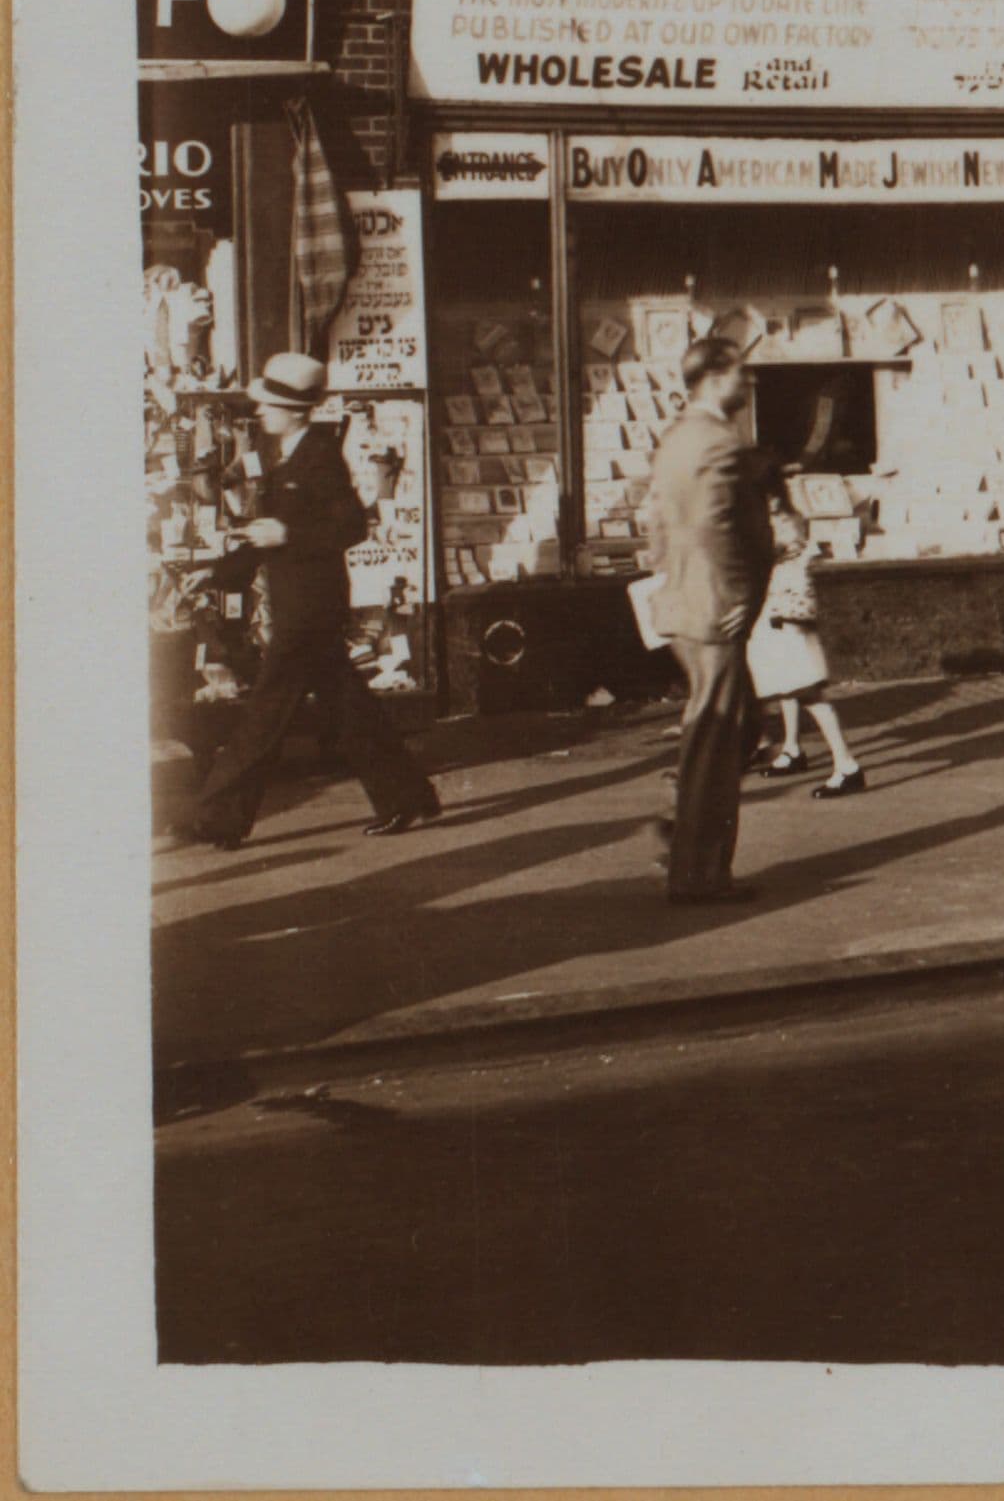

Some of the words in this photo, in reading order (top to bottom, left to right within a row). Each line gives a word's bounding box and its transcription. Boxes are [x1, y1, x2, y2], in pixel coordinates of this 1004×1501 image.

[451, 14, 613, 45] PUBLISHED
[623, 17, 653, 45] AT
[660, 19, 718, 46] OUR
[724, 21, 778, 46] OWN
[477, 53, 718, 89] WHOLESALE
[441, 151, 537, 181] ENTRANCE
[571, 146, 627, 189] BUY
[627, 148, 691, 189] ONLY
[697, 149, 814, 189] AMERICAN
[819, 150, 879, 189] MADE
[882, 151, 960, 189] JEWISH
